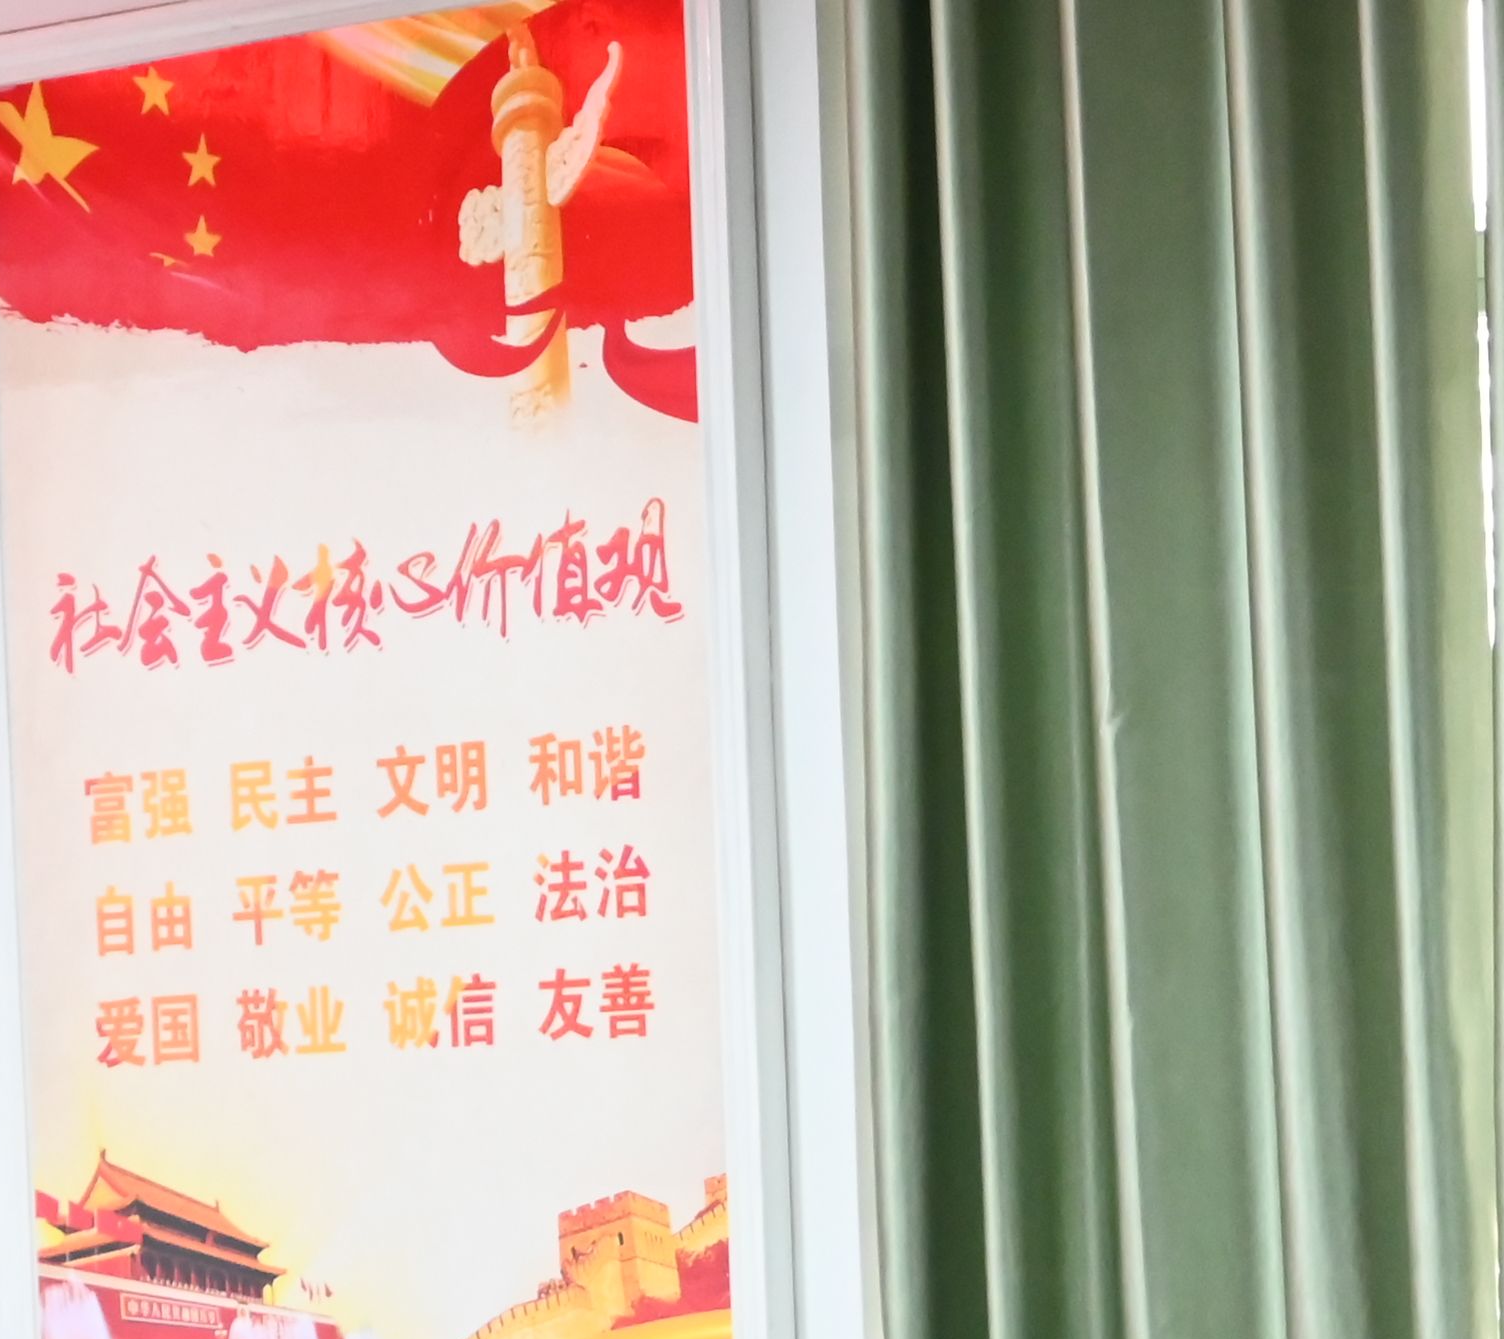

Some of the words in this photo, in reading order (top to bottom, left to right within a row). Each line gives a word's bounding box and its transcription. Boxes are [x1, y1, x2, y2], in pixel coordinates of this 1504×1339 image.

[49, 496, 684, 674] 社会主义核心价值观
[83, 767, 195, 846] 富强
[229, 755, 339, 833] 民主
[376, 741, 490, 819] 文明
[528, 724, 648, 807] 和谐
[95, 880, 195, 957] 自由
[231, 868, 344, 946] 平等
[379, 860, 497, 934] 公正
[533, 844, 652, 922] 法治
[95, 992, 202, 1070] 爱国
[235, 984, 349, 1060] 敬业
[383, 972, 499, 1051] 诚信
[538, 961, 656, 1041] 友善
